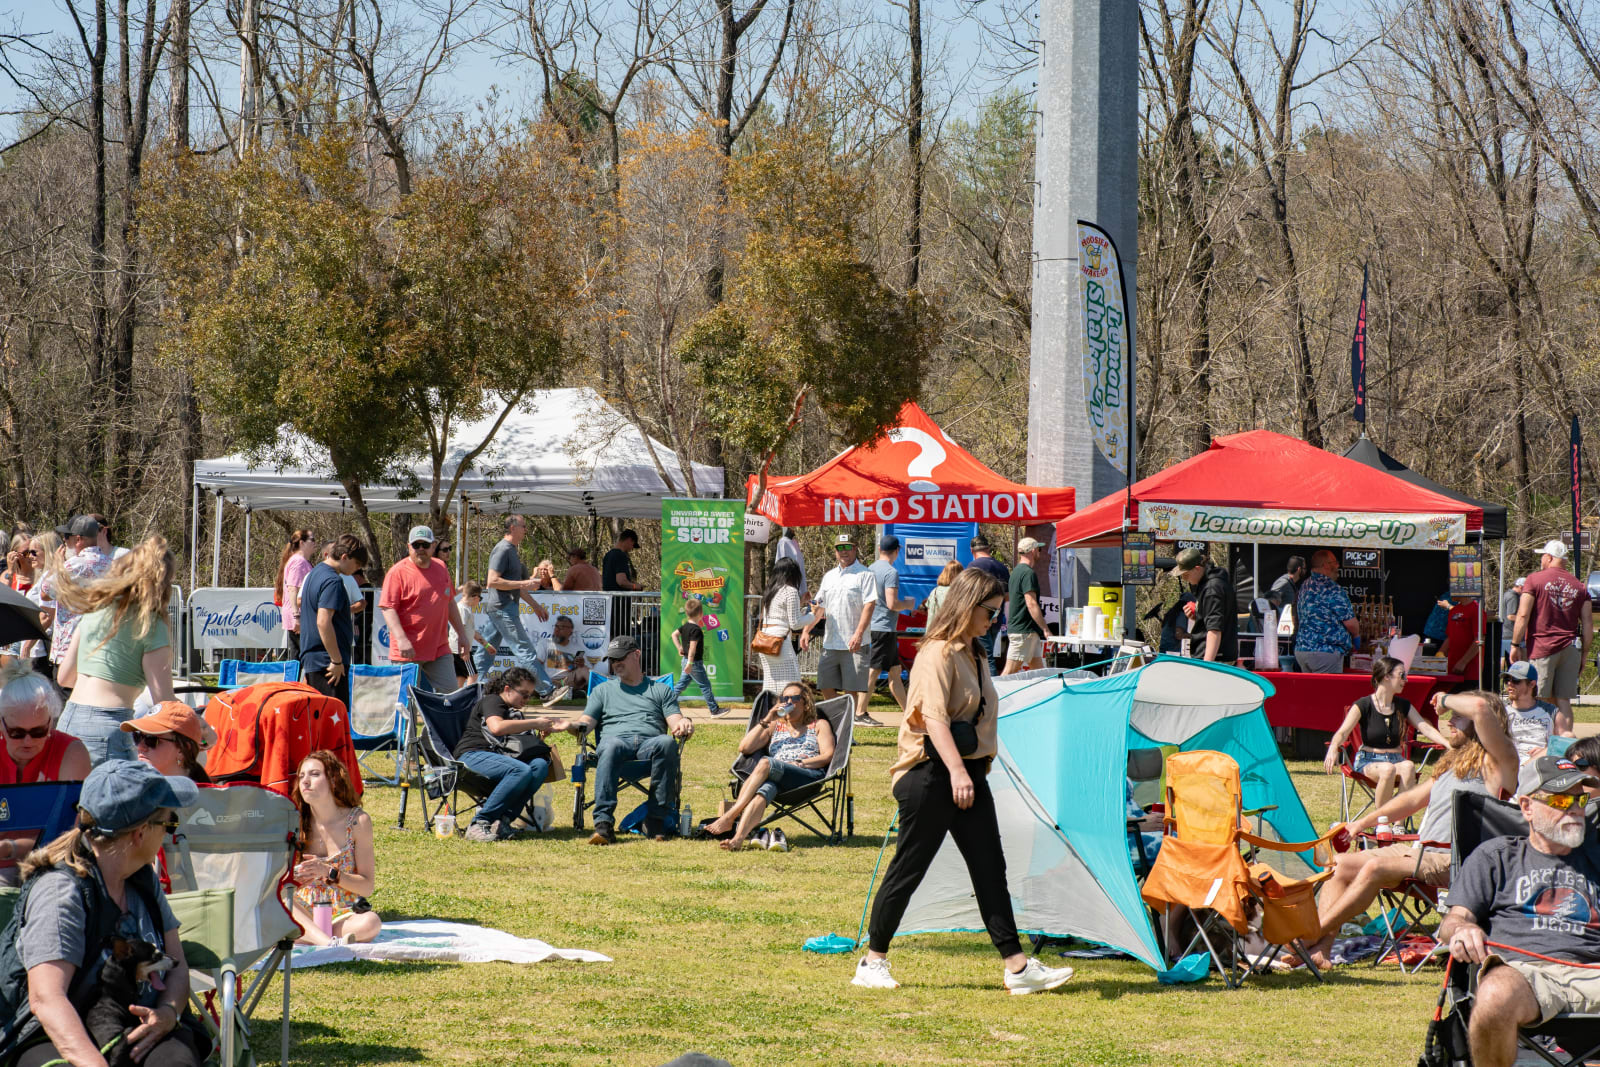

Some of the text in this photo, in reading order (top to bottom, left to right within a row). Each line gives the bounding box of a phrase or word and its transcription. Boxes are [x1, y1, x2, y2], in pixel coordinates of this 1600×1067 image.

[1105, 305, 1122, 408] Lemon
[824, 492, 1038, 522] INFO STATION
[1148, 505, 1179, 515] HOOSIER
[670, 516, 735, 528] BURST OF
[1190, 511, 1416, 545] Lemon Shake-Up
[677, 527, 730, 544] SOUR
[744, 528, 755, 536] 20
[1178, 540, 1205, 550] ORDER
[907, 547, 923, 556] WC
[1345, 551, 1377, 560] PICK-UP
[1337, 568, 1391, 581] munity
[682, 576, 724, 589] Starburst
[196, 606, 208, 618] The
[519, 603, 549, 614] Rok
[552, 603, 579, 615] Fest
[1040, 600, 1060, 612] irts
[201, 605, 252, 636] pulse
